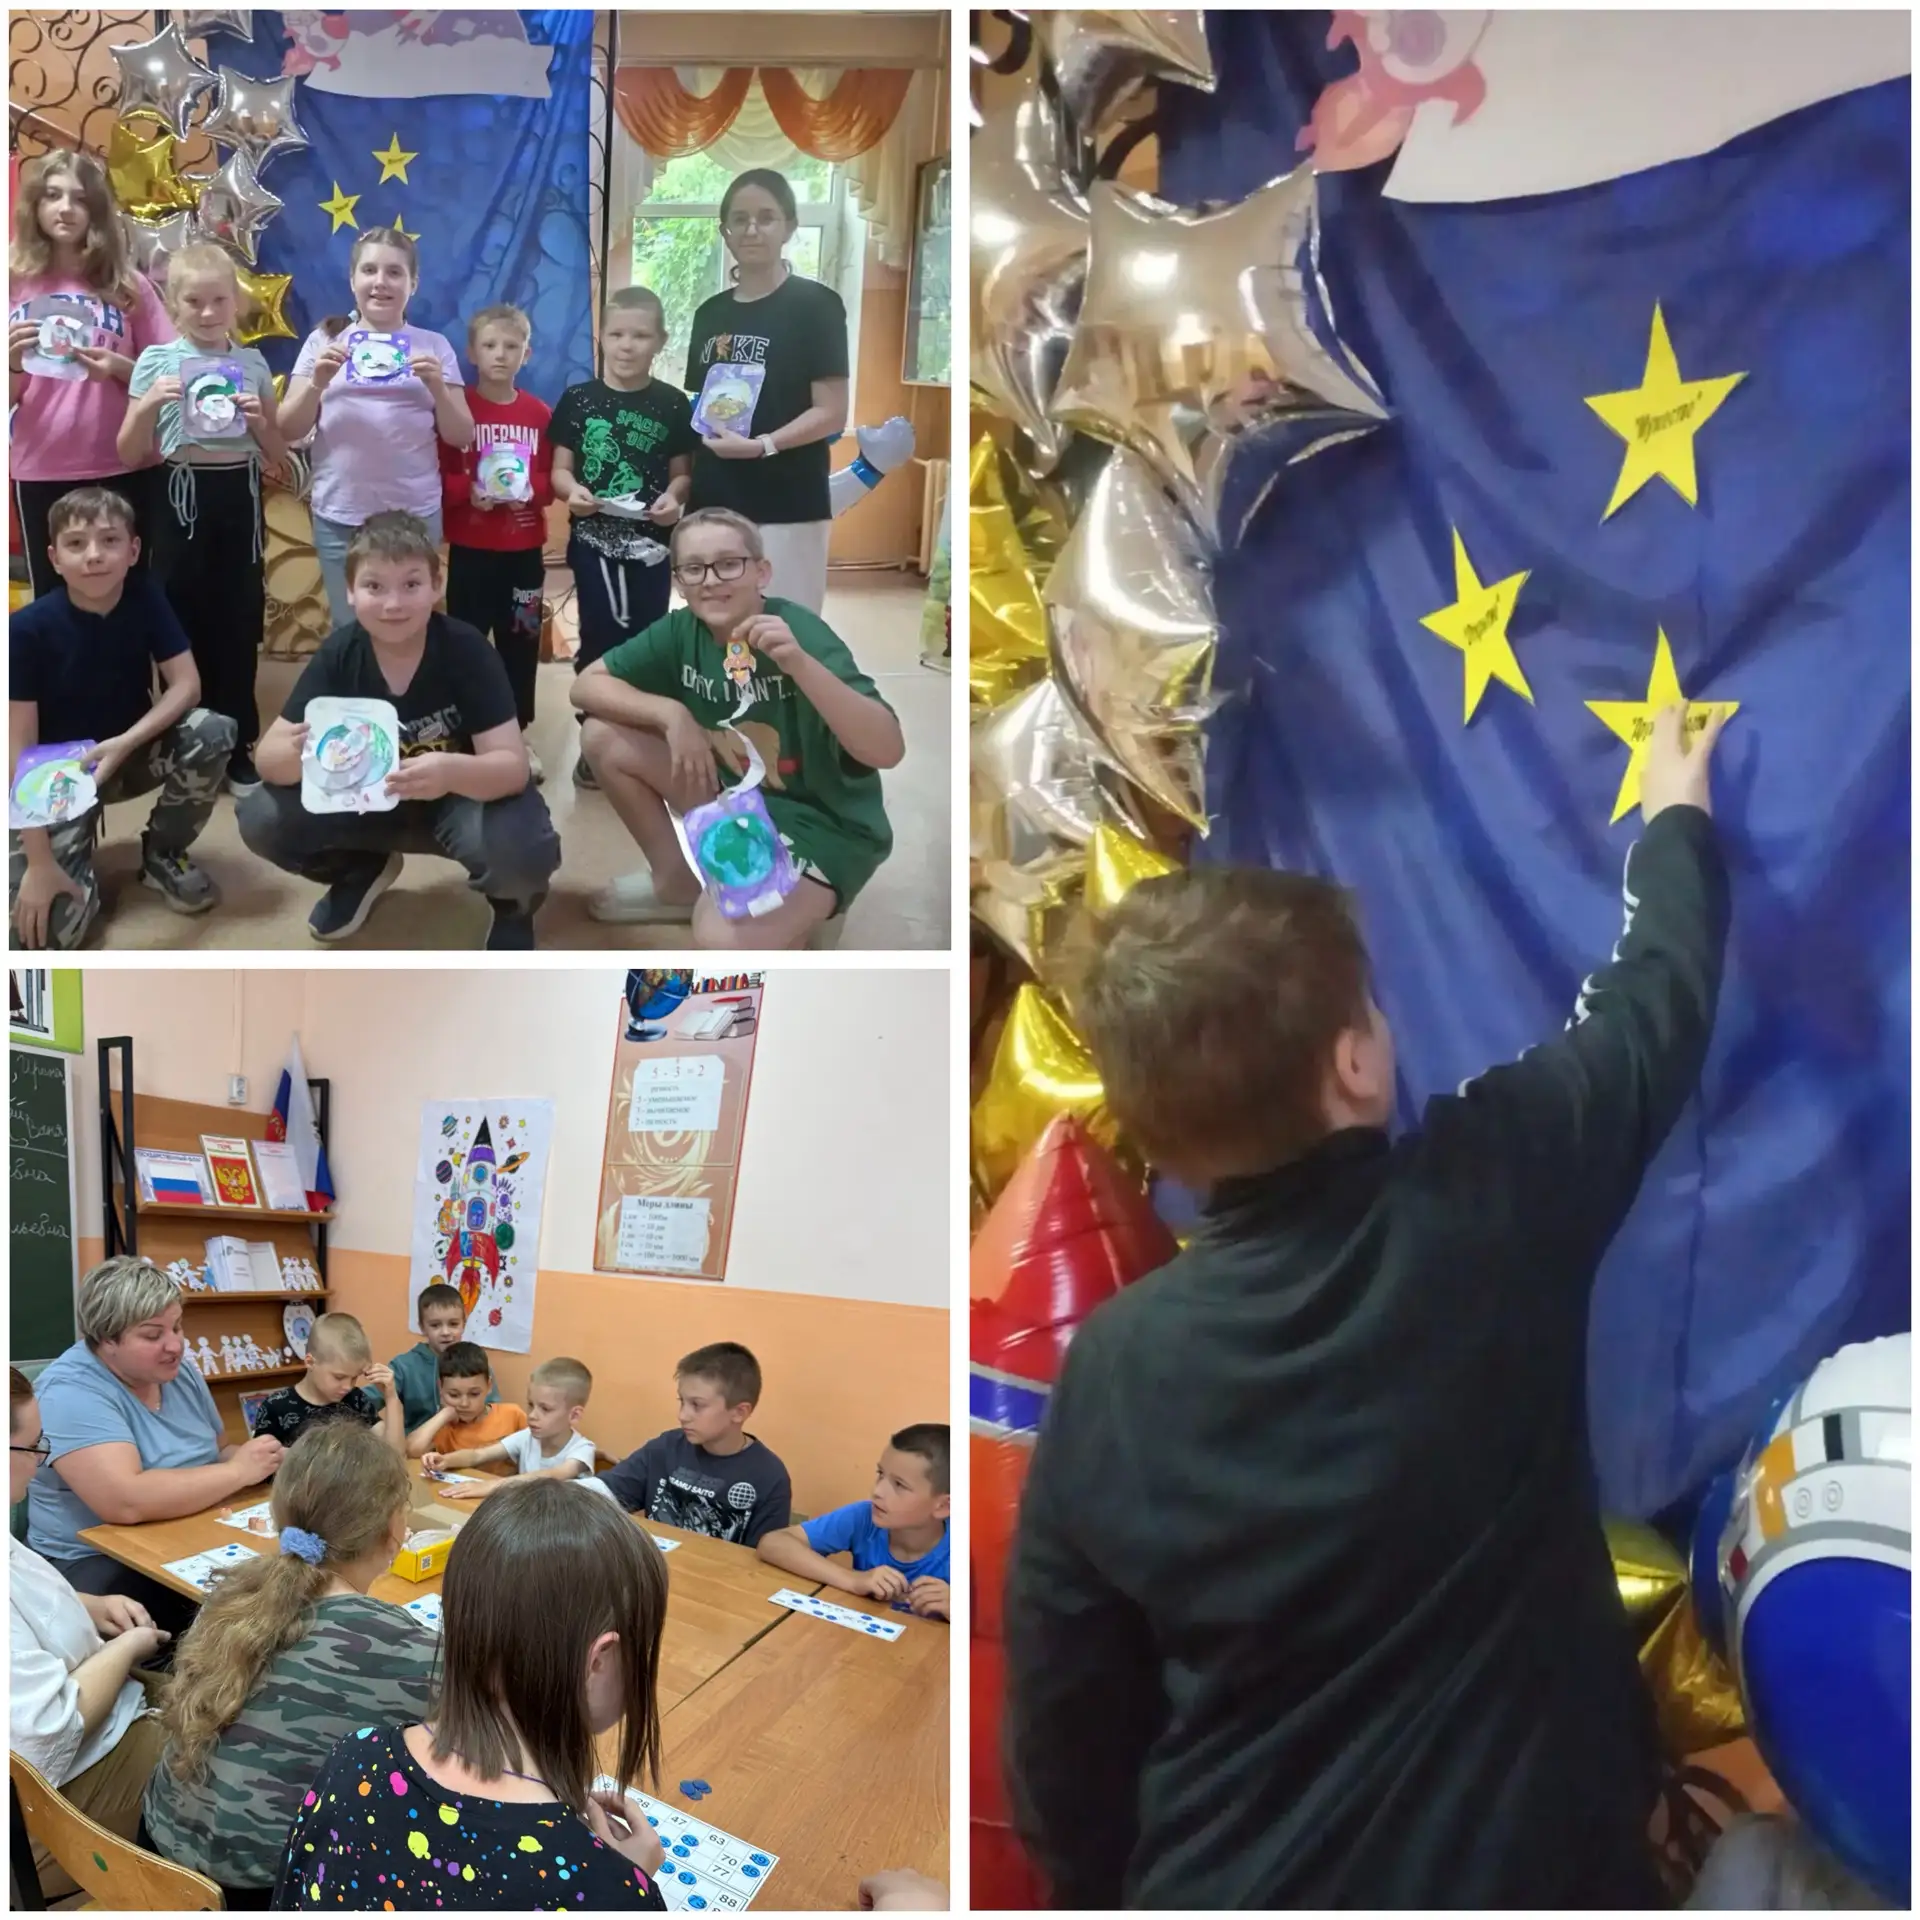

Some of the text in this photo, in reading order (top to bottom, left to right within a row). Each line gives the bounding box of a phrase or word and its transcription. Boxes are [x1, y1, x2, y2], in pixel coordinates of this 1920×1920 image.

[697, 1064, 705, 1077] 2
[690, 1486, 716, 1499] SAITO
[671, 1815, 688, 1826] 47
[709, 1834, 726, 1846] 63
[721, 1853, 738, 1867] 70
[712, 1864, 730, 1877] 77
[719, 1894, 738, 1908] 88
